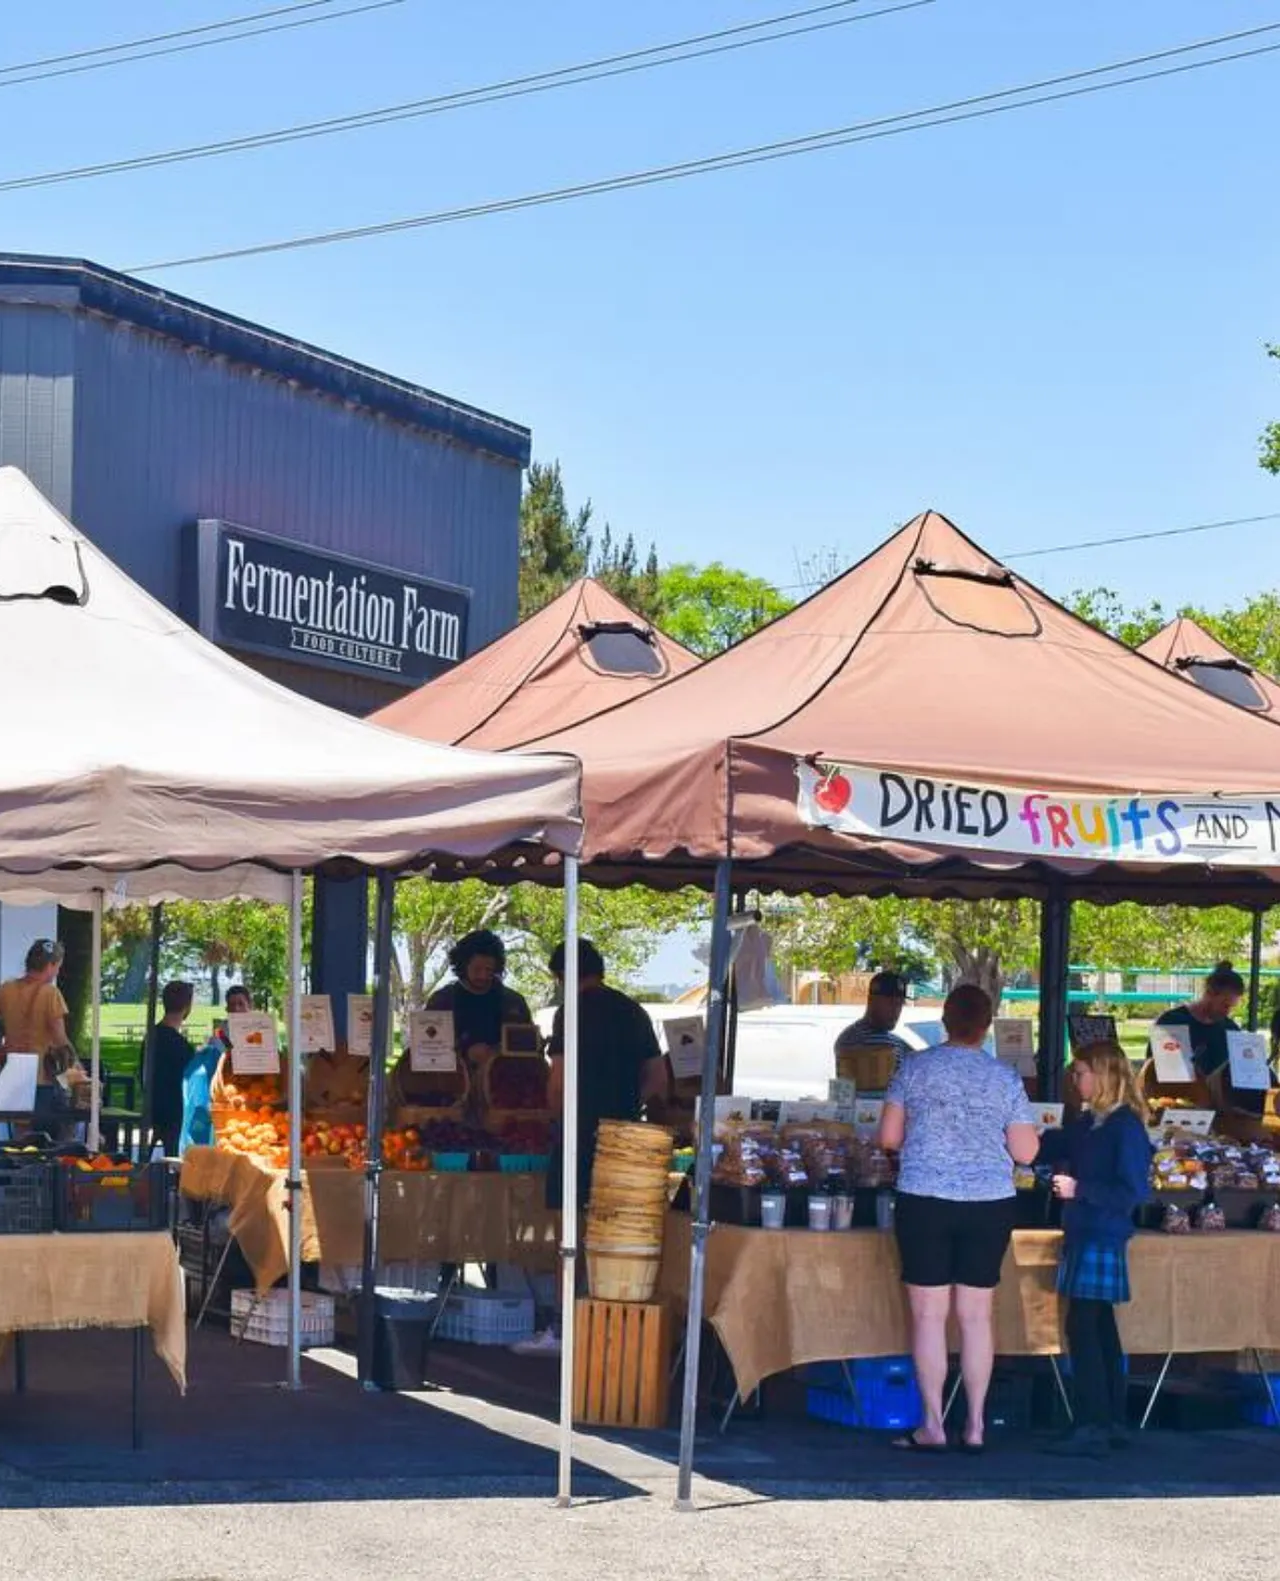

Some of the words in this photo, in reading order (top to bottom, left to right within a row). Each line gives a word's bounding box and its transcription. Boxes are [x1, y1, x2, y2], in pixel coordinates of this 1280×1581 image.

[225, 539, 394, 646] Fermentation
[401, 585, 459, 661] Farm
[303, 633, 334, 653] FOOD
[339, 643, 392, 667] CULTURE
[1194, 814, 1249, 839] AND
